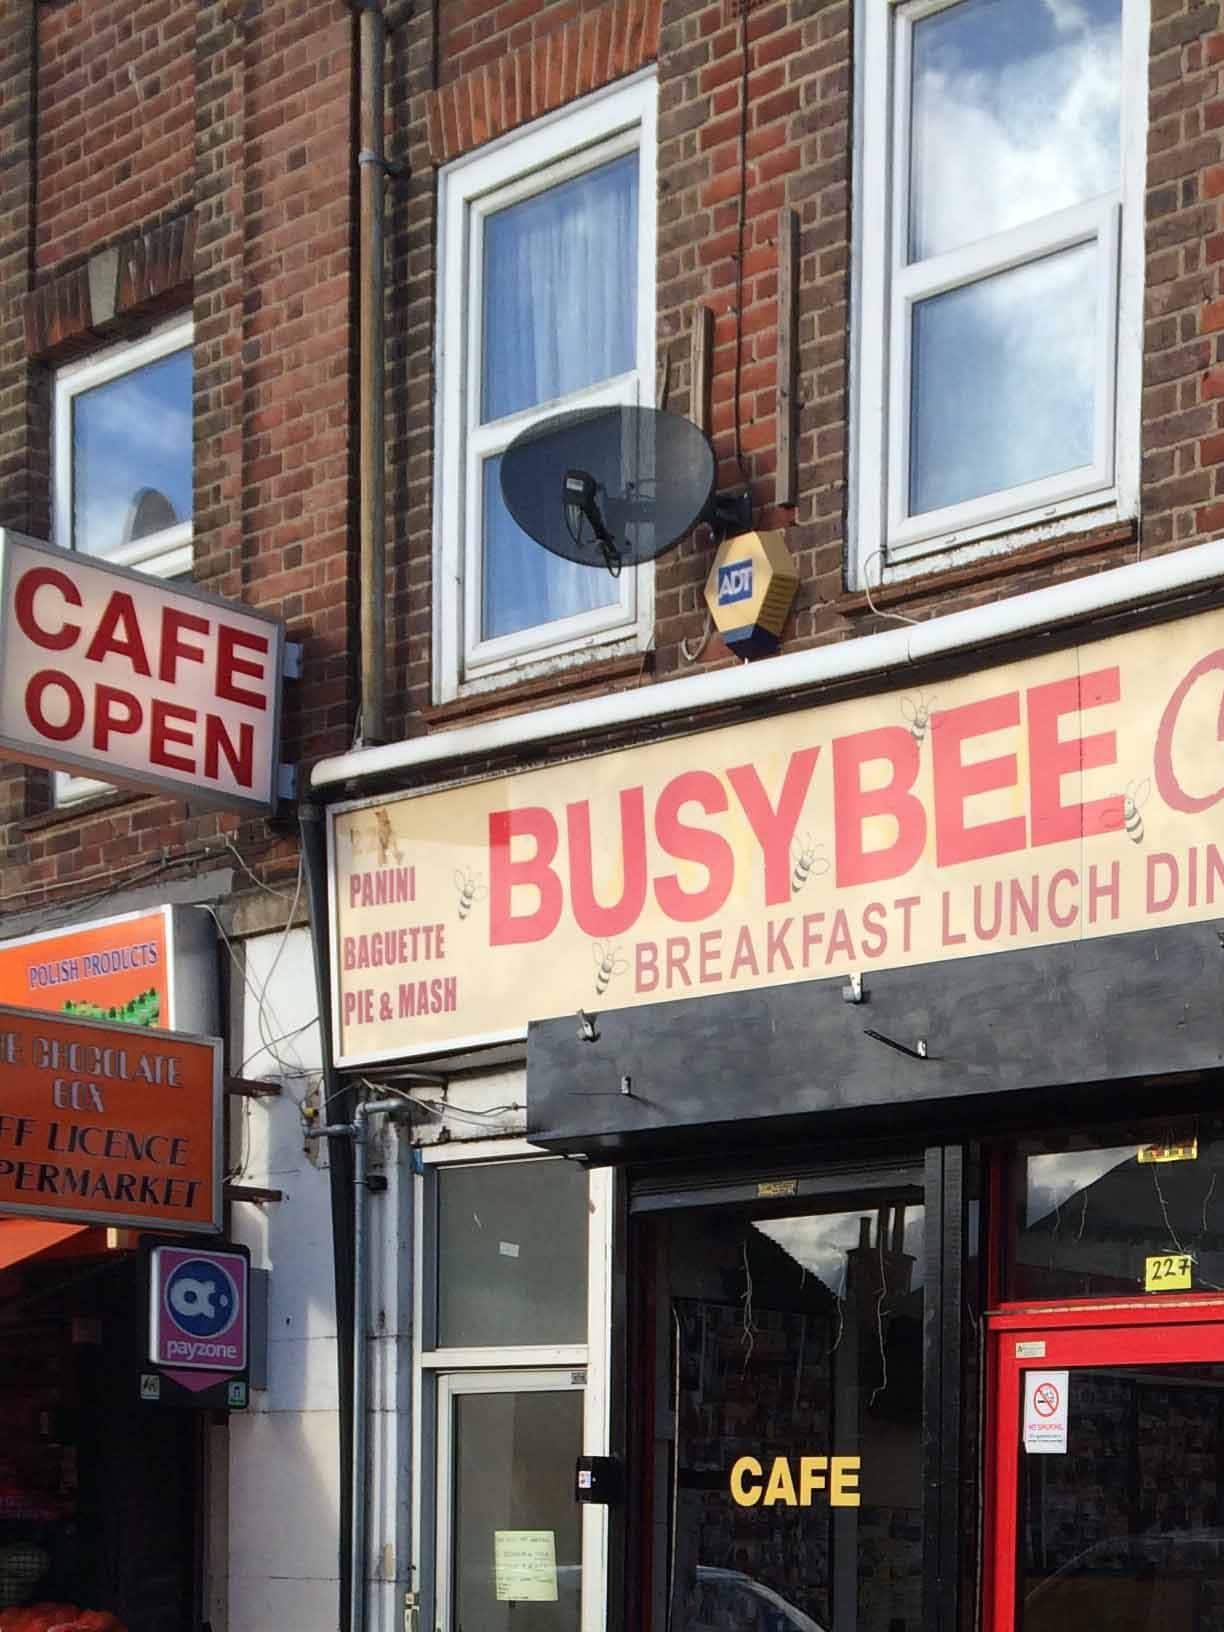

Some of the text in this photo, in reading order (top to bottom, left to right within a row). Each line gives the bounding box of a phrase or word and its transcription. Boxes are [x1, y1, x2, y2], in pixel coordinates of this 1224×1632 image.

[719, 568, 752, 599] ADT
[14, 566, 269, 712] CAFE
[25, 669, 254, 788] OPEN
[350, 866, 416, 908] PANINI
[343, 923, 445, 971] BAGUETTE
[635, 895, 922, 994] BREAKFAST
[942, 861, 1121, 946] LUNCH
[29, 942, 158, 988] POLISH PRODUCTS
[343, 976, 457, 1026] PIE & MASH
[32, 1036, 184, 1088] CHOCOLATE
[0, 1115, 191, 1167] FF LICENCE
[0, 1159, 203, 1209] PERMARKET
[1152, 1257, 1190, 1281] 227
[167, 1340, 238, 1360] payzone
[730, 1456, 861, 1507] CAFE
